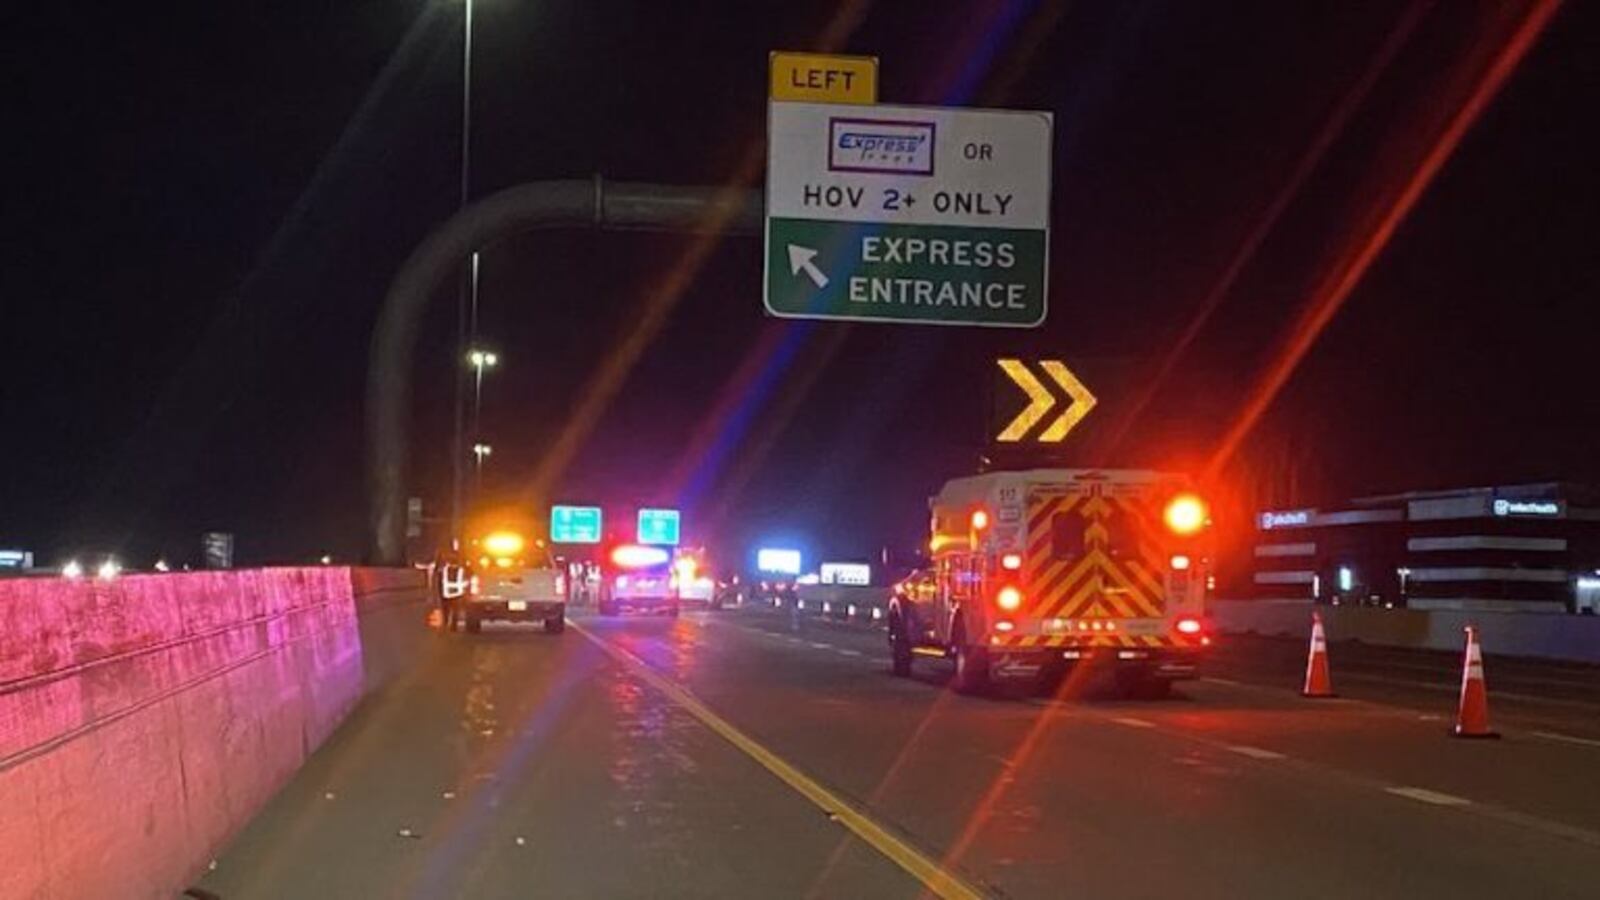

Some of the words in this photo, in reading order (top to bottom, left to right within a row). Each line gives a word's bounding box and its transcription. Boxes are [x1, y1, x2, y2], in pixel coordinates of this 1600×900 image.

[791, 69, 855, 90] LEFT
[838, 132, 920, 160] Express
[963, 143, 992, 161] OR
[803, 185, 864, 210] HOV
[882, 188, 916, 213] 2+
[932, 192, 1013, 217] ONLY
[861, 237, 1015, 268] EXPRESS
[849, 277, 1026, 310] ENTRANCE
